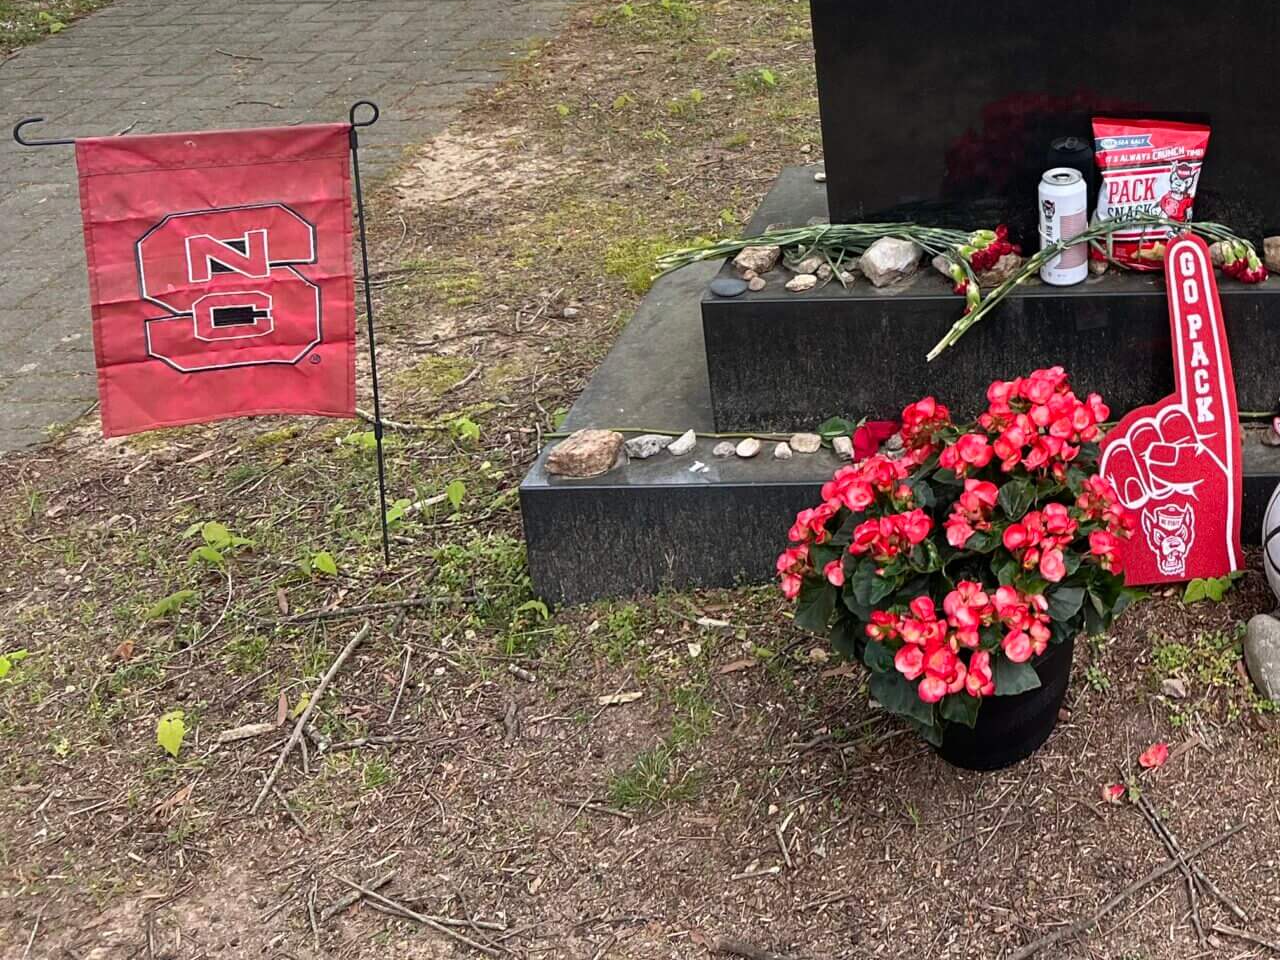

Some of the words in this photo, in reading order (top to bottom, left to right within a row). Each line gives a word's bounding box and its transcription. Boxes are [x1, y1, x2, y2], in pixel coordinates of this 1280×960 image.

[1120, 153, 1151, 162] ALWAYS
[1152, 146, 1185, 160] CRUNCH
[1107, 177, 1156, 204] PACK
[1178, 251, 1198, 304] GO
[1186, 314, 1216, 424] PACK
